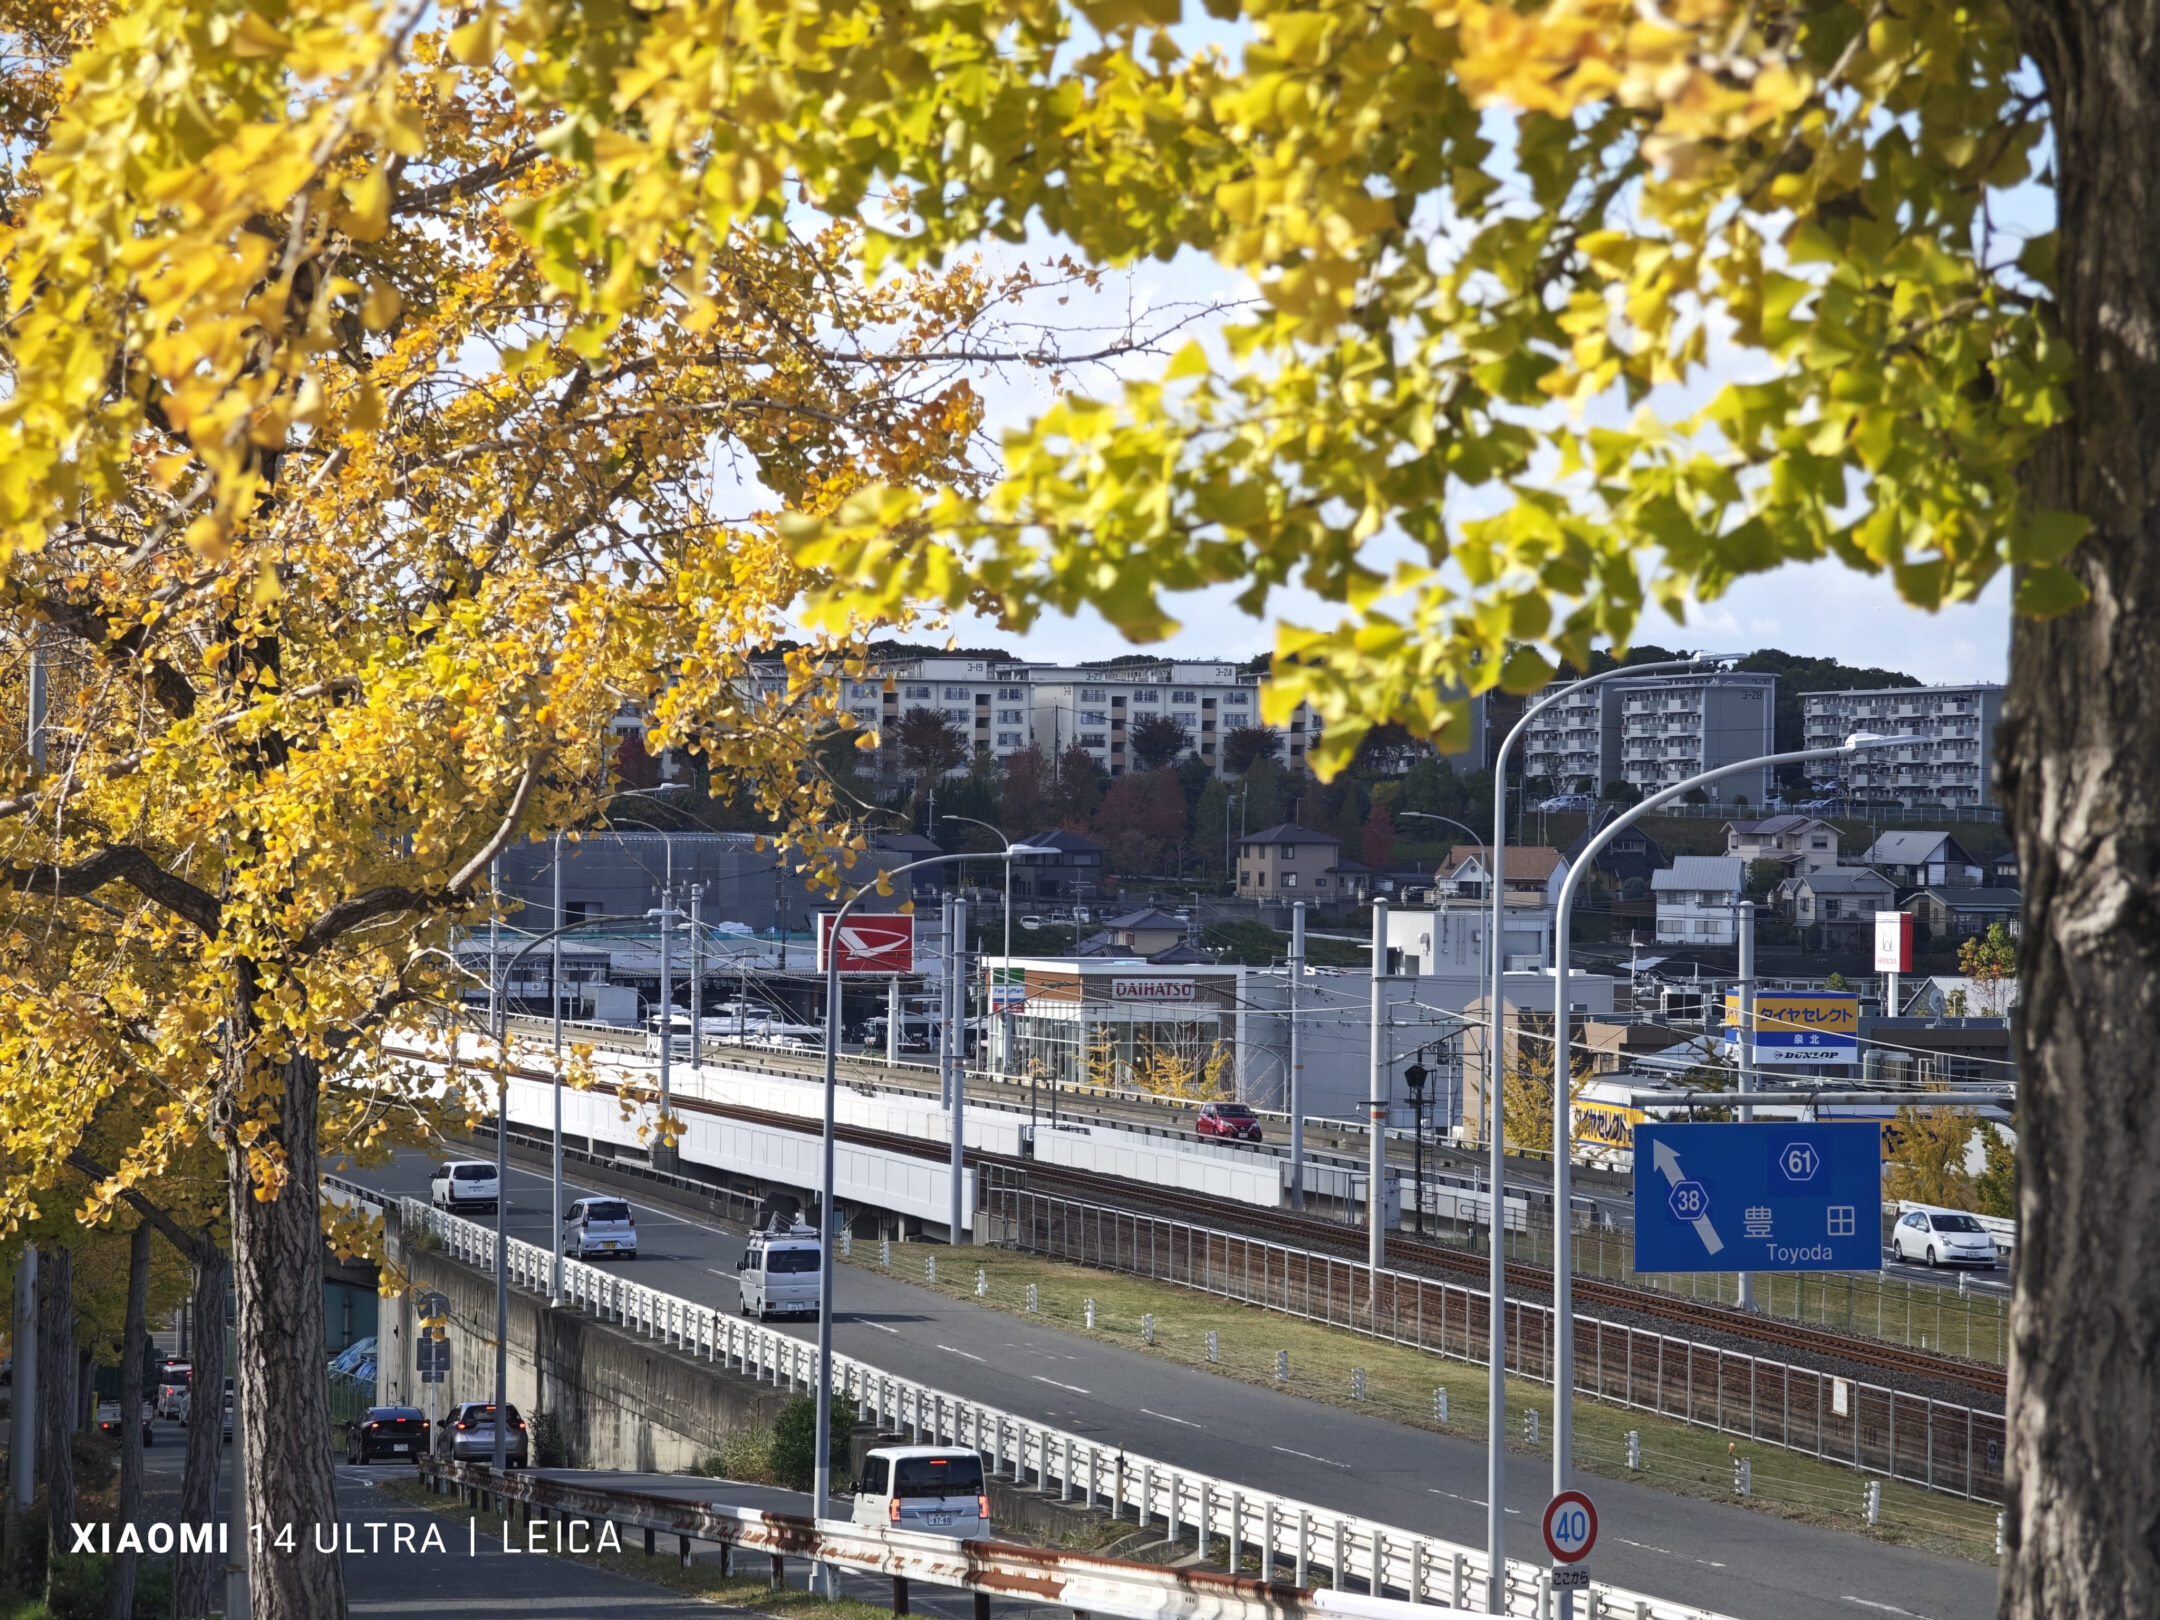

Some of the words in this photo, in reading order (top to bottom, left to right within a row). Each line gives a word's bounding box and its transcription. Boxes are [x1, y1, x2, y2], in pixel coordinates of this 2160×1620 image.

[1877, 957, 1897, 965] HONDA
[1116, 982, 1191, 996] DAIHATSU
[1760, 1007, 1854, 1023] タイヤセレクト
[1784, 1051, 1839, 1059] DUNLOP
[1788, 1150, 1811, 1174] 61
[1677, 1190, 1700, 1212] 38
[1766, 1243, 1833, 1264] Toyoda
[1555, 1510, 1586, 1543] 40
[1553, 1571, 1589, 1586] ここから
